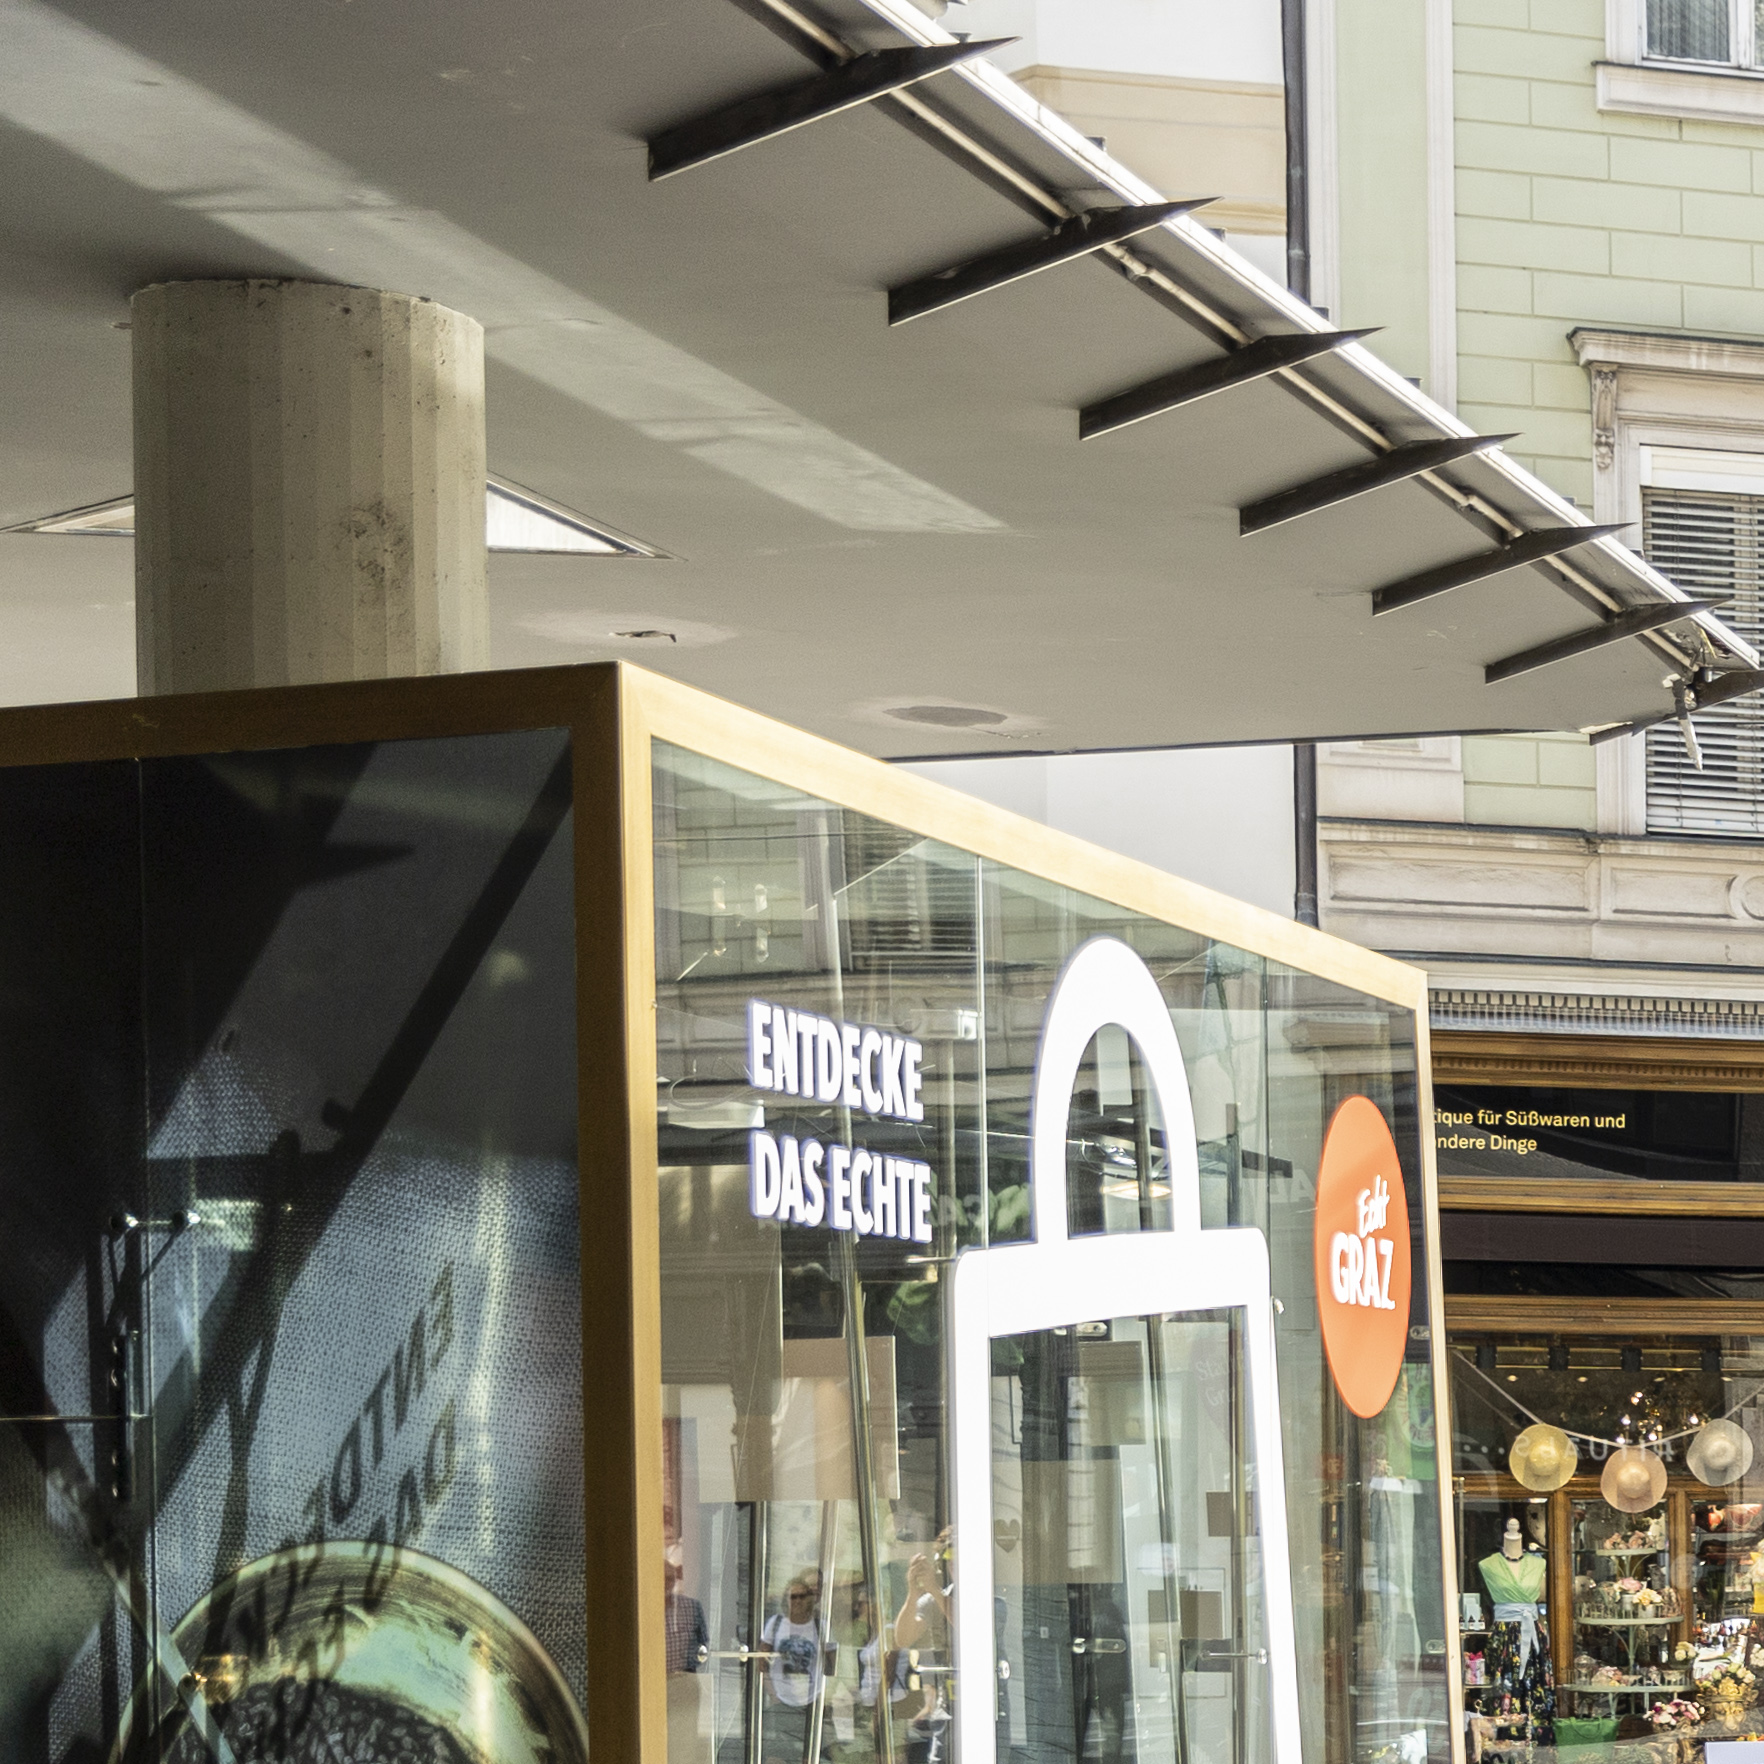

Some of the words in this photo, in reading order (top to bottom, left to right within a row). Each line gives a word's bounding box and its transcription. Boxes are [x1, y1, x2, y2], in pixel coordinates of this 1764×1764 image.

[749, 999, 924, 1122] ENTDECKE
[1478, 1109, 1502, 1125] für
[1506, 1110, 1590, 1128] Süßwaren
[1595, 1113, 1626, 1128] und
[1490, 1134, 1537, 1154] Dinge
[750, 1129, 825, 1227] DAS
[827, 1143, 932, 1244] ECHTE
[1330, 1232, 1396, 1310] GRAZ
